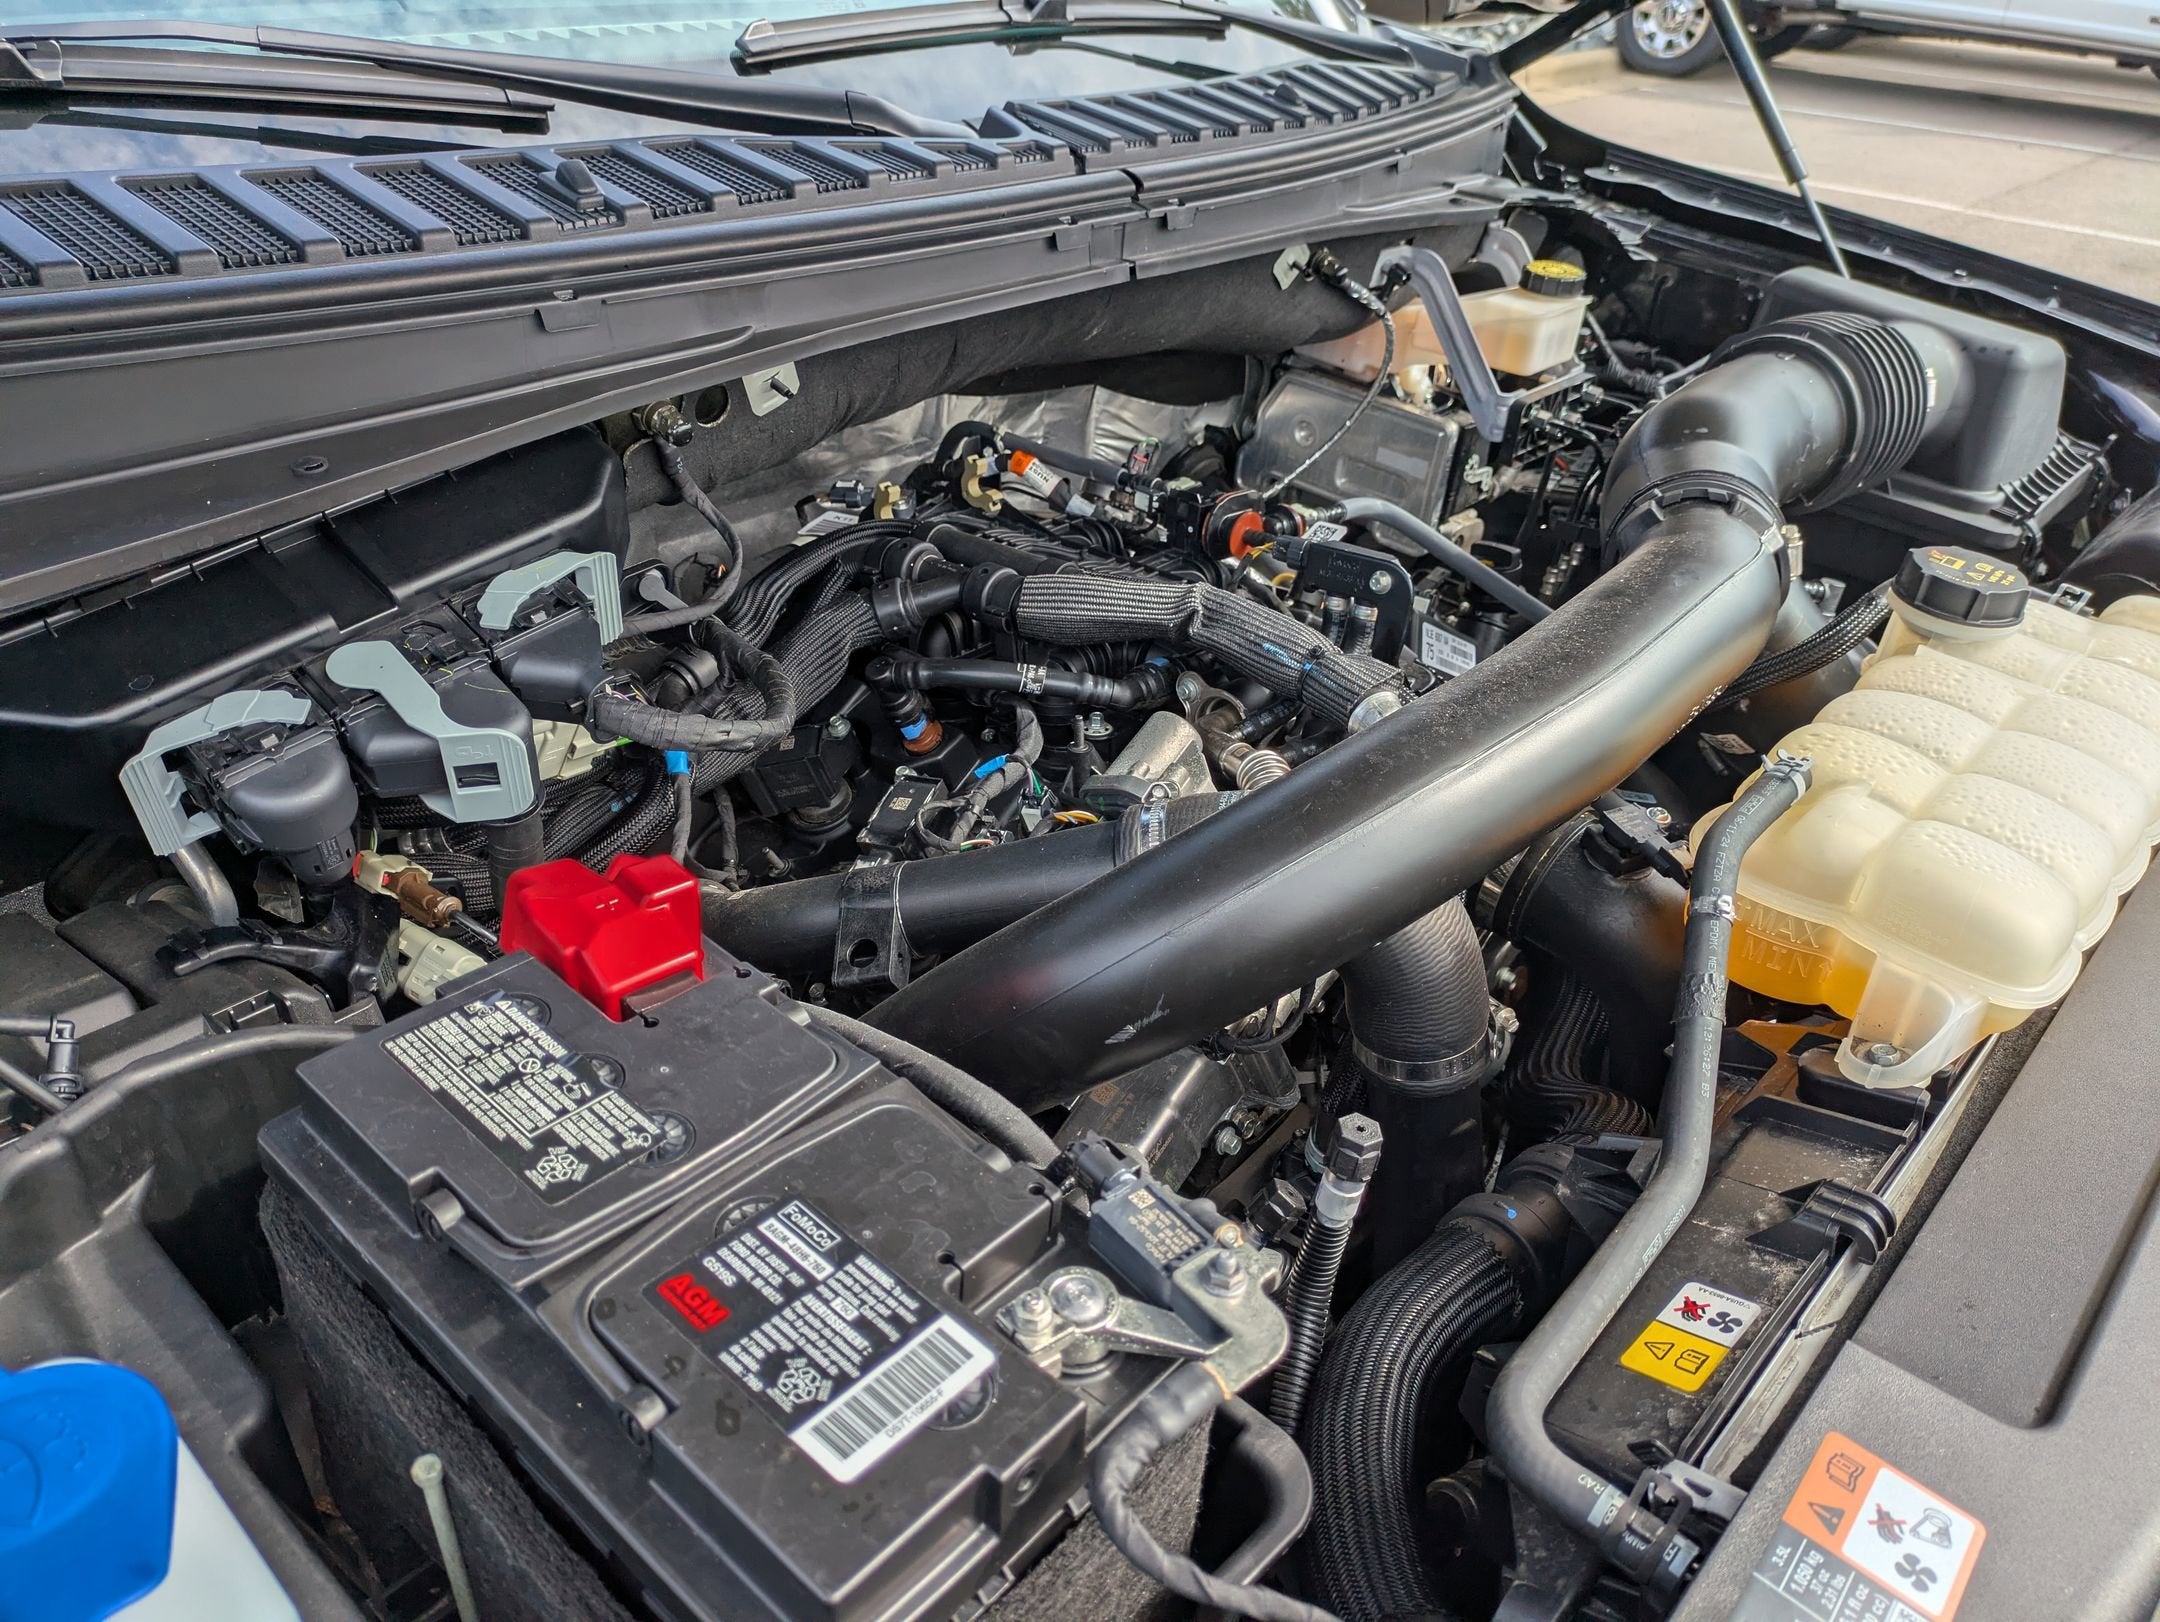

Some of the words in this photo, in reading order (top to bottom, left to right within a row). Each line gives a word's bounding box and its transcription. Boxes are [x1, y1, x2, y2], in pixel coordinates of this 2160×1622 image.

[1749, 906, 1821, 950] MAX
[1742, 935, 1814, 978] MIN
[781, 1205, 835, 1248] FoMoCo
[700, 1254, 739, 1287] G519S
[664, 1269, 733, 1327] AGM
[1771, 1545, 1791, 1567] 3.5L
[1789, 1564, 1814, 1594] 1.050
[1809, 1549, 1825, 1570] kg
[1809, 1577, 1822, 1596] 37
[1817, 1568, 1831, 1583] oz
[1855, 1583, 1870, 1601] oz
